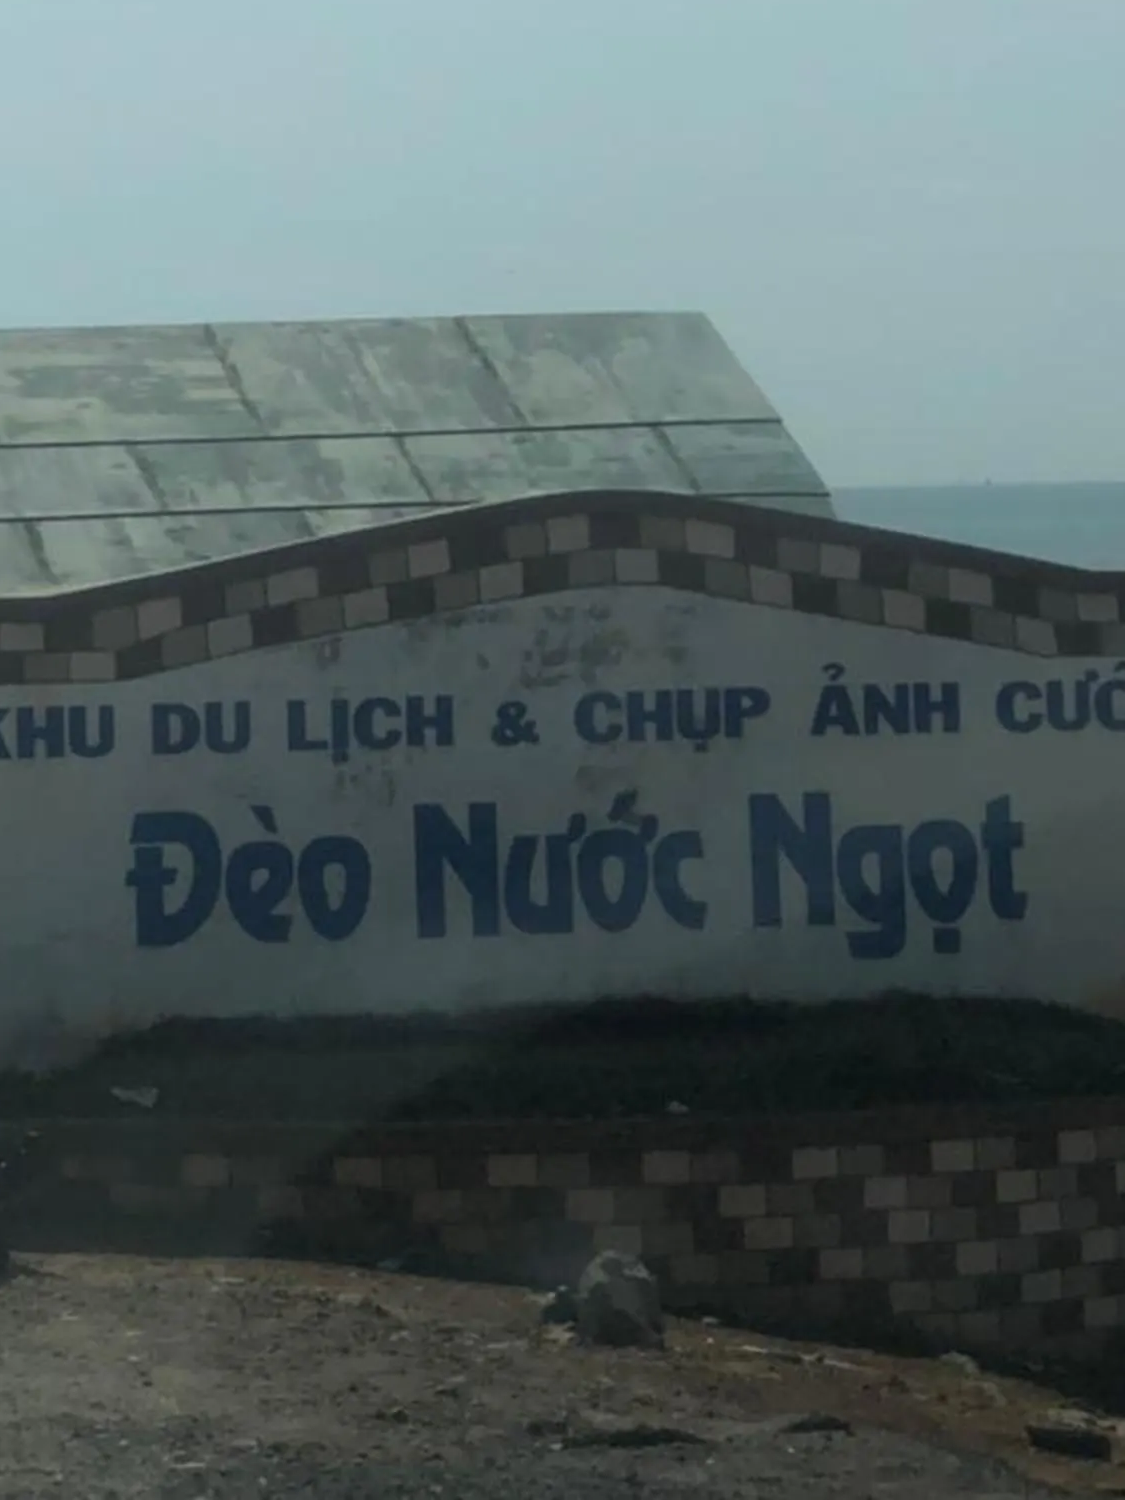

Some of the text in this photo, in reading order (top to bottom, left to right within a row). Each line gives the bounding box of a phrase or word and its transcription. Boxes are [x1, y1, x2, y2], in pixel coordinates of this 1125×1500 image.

[150, 701, 251, 756] DU
[286, 696, 455, 764] LỊCH
[491, 700, 539, 746] &
[573, 686, 771, 754] CHỤP
[810, 662, 961, 736] ẢNH
[125, 788, 1028, 959] Đèo Nước Ngọt
